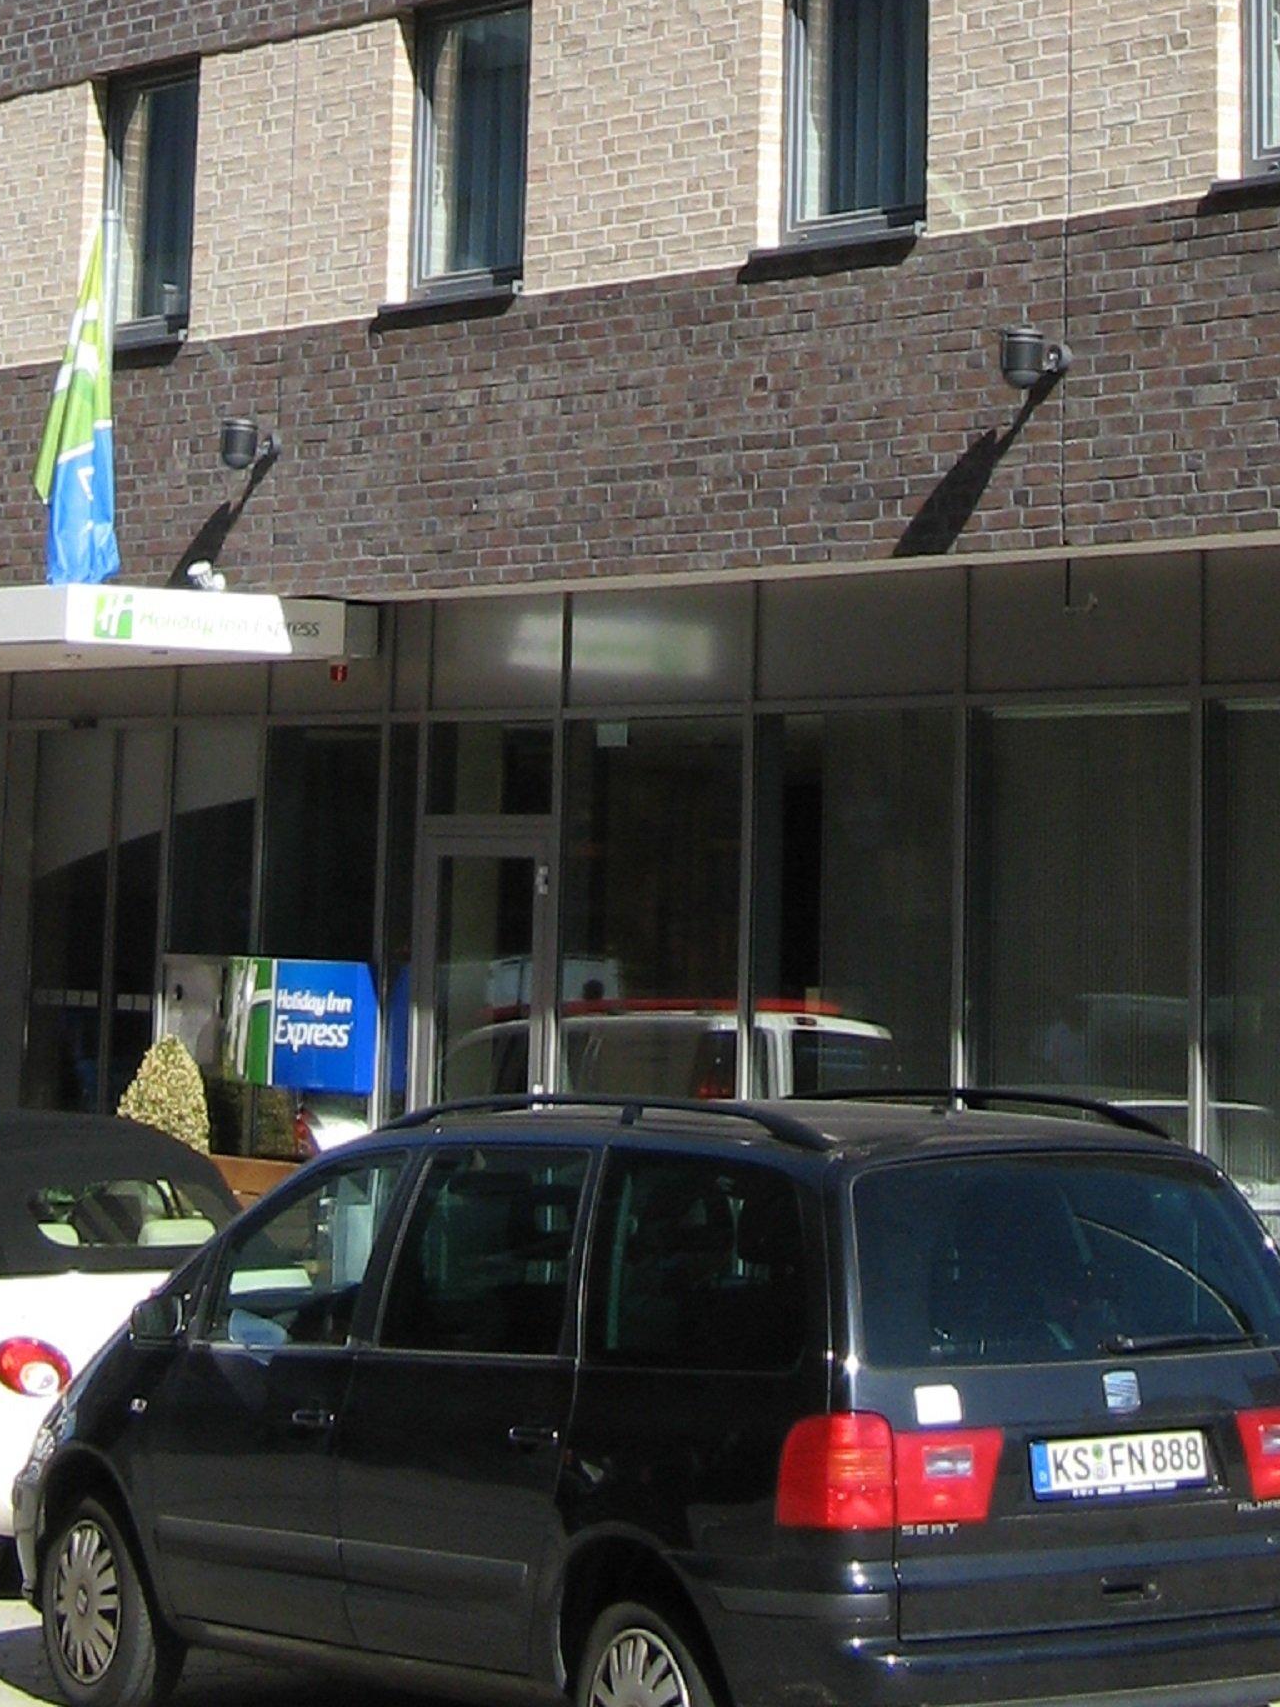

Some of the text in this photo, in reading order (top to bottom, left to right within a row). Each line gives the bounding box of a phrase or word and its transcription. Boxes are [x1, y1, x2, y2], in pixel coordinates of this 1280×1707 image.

[276, 988, 353, 1016] Holiday Inn
[275, 1014, 351, 1053] Express
[901, 1522, 959, 1536] SEAT
